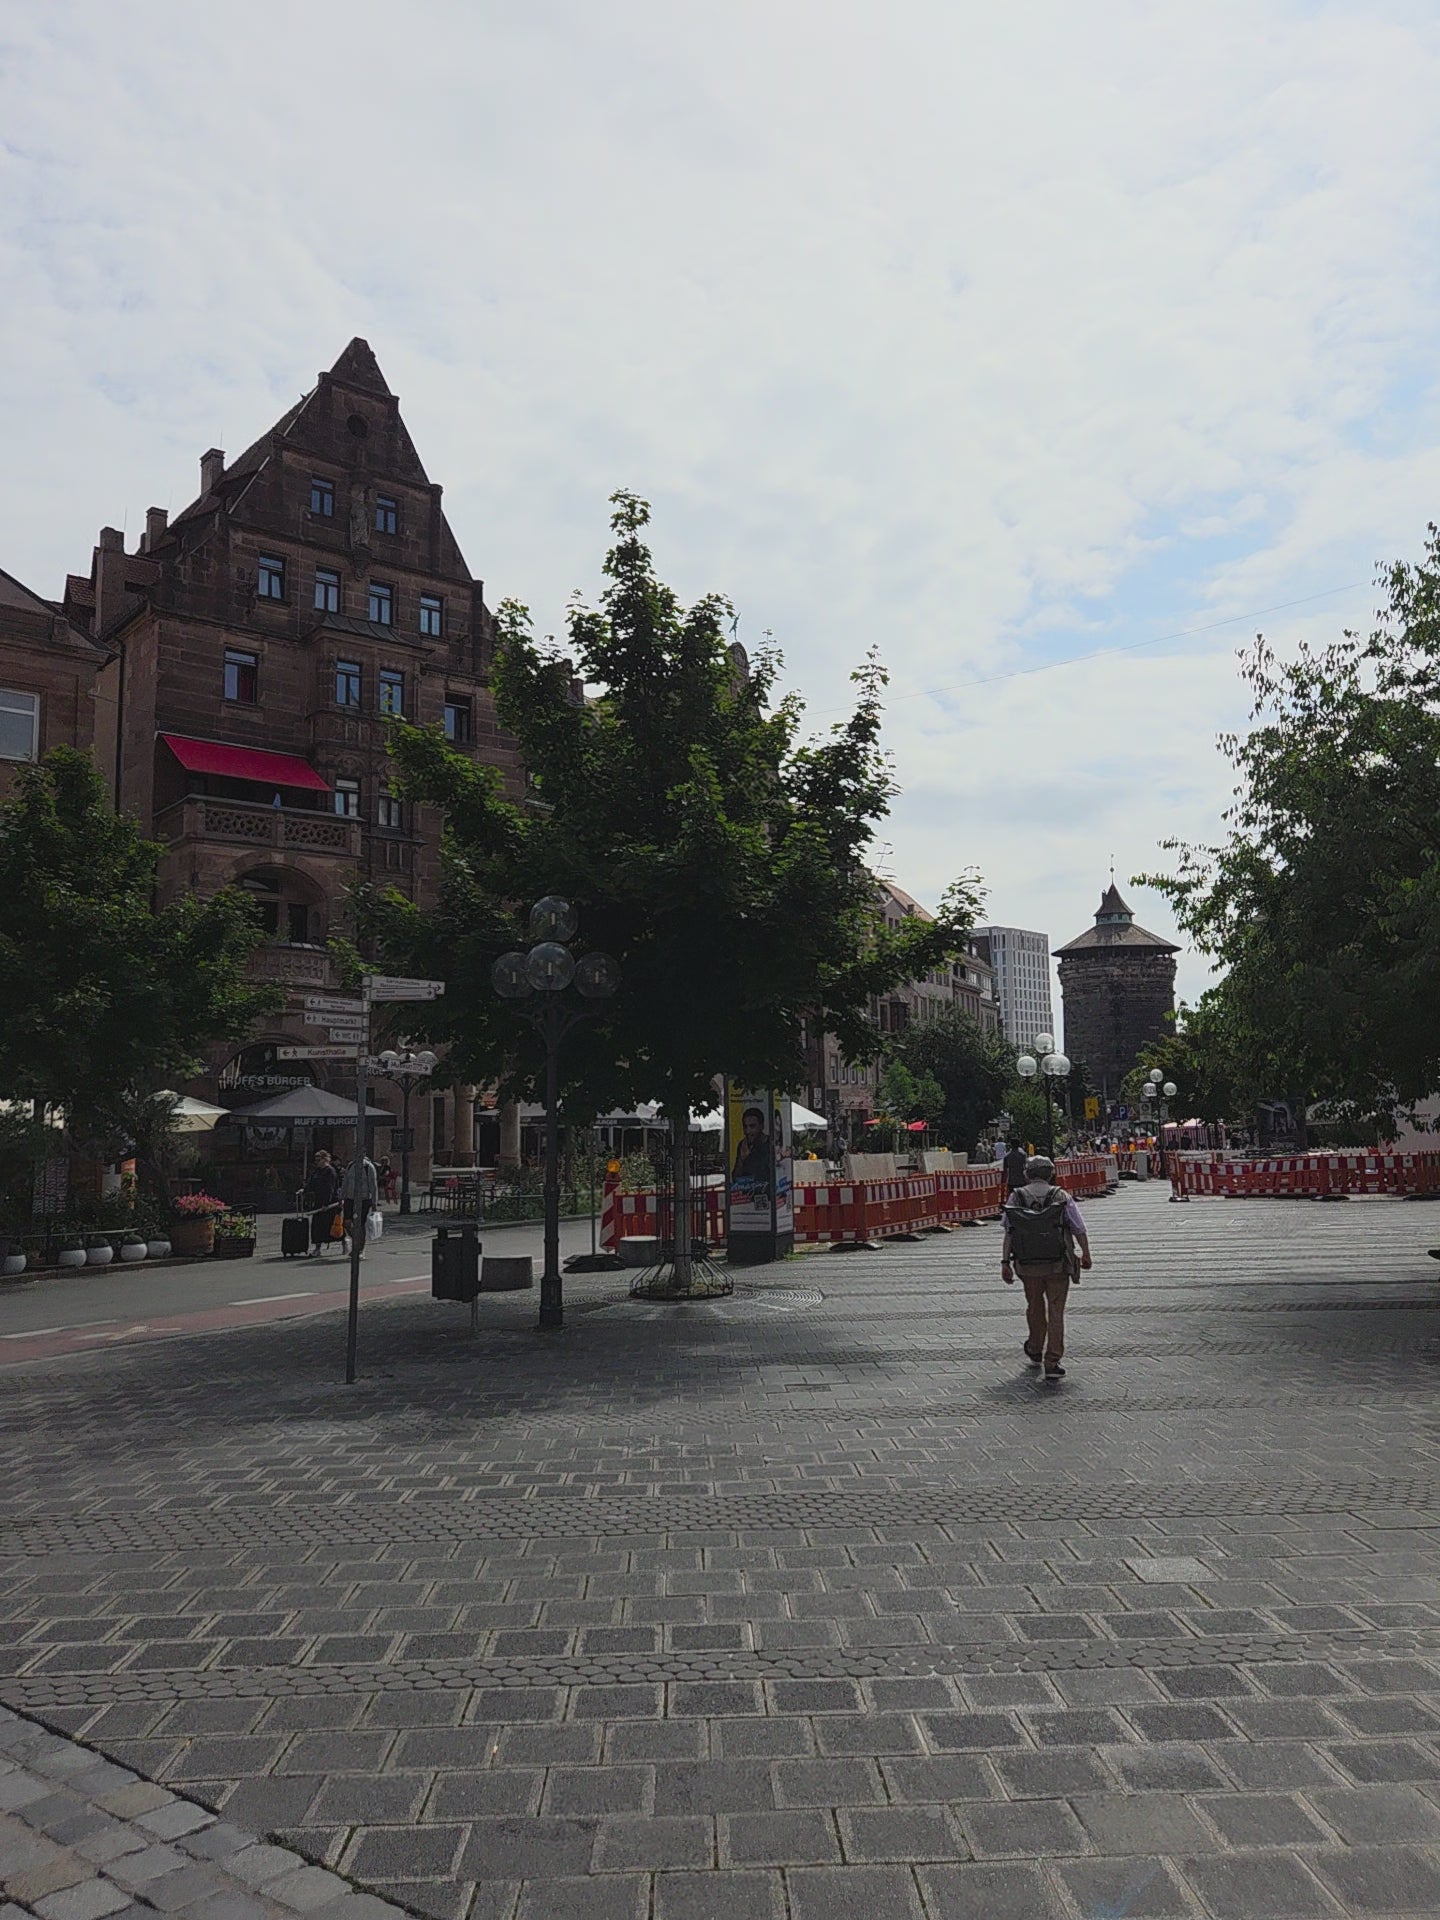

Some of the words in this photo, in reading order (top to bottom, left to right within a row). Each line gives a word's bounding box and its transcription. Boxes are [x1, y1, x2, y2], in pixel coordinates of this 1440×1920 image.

[321, 1015, 357, 1026] Hauptmarkt
[307, 1046, 347, 1057] Kunsthalle
[326, 1118, 358, 1127] BURGE
